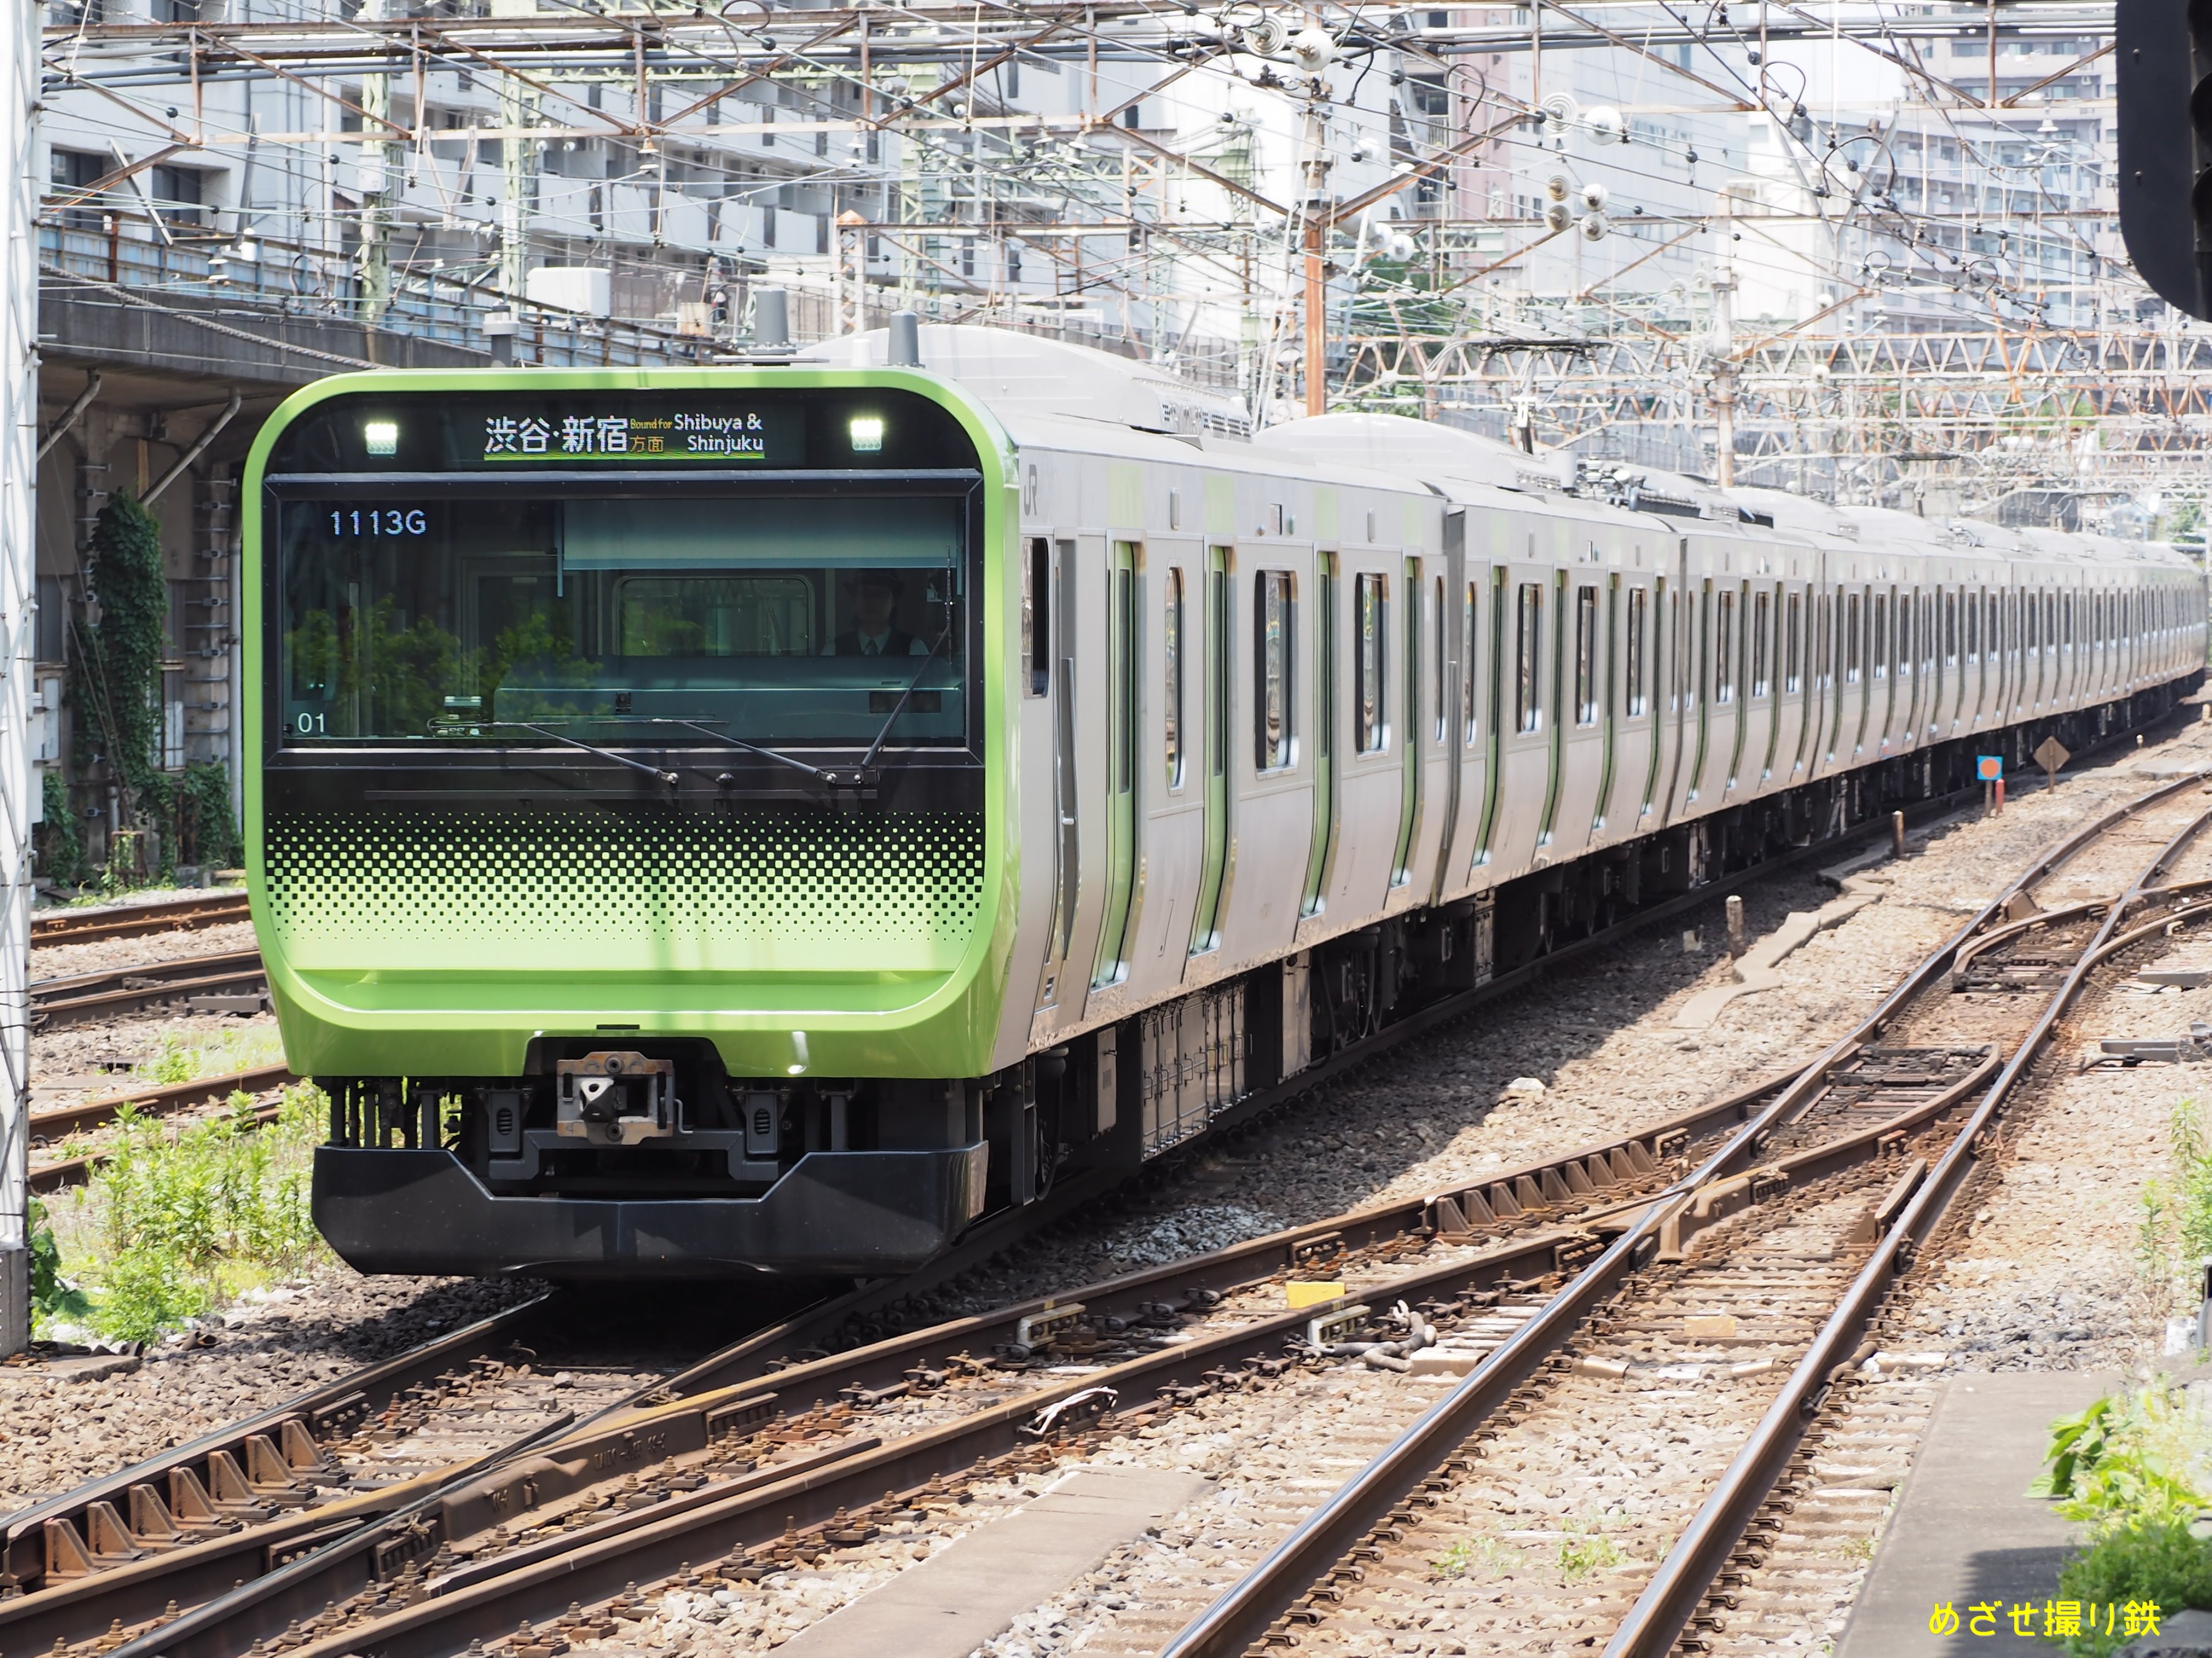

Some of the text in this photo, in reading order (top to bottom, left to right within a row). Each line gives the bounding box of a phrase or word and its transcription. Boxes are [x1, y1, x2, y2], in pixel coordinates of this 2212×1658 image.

[630, 418, 673, 429] Bound for
[674, 413, 763, 434] Shibuya &
[629, 435, 664, 453] 方面
[687, 434, 764, 455] Shinjuku
[1024, 464, 1037, 516] JR
[330, 509, 427, 535] 1113G
[297, 713, 327, 733] 01
